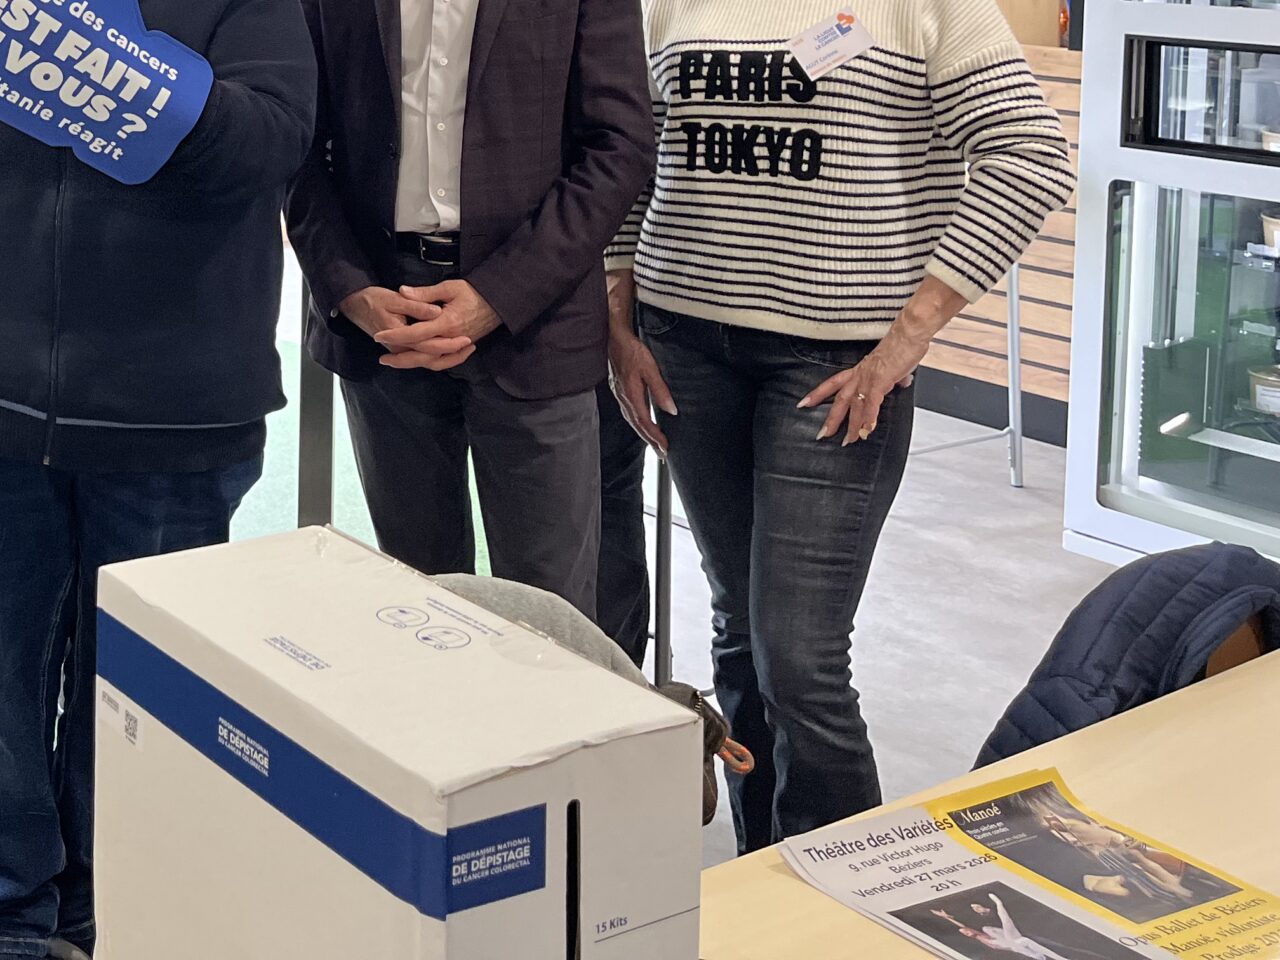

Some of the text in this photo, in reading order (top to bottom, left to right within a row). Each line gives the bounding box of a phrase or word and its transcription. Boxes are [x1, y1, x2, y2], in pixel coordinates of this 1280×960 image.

[69, 0, 105, 32] des
[107, 28, 179, 81] cancers
[4, 43, 117, 123] VOUS
[116, 112, 148, 140] ?
[54, 30, 152, 102] FAIT
[146, 87, 172, 118] !
[679, 50, 818, 103] PARIS
[58, 118, 124, 161] réagit
[680, 122, 823, 182] TOKYO
[218, 724, 269, 769] DE DÉPISTAGE
[955, 803, 1002, 825] Manoé
[452, 836, 531, 863] PROGRAMME NATIONAL
[803, 815, 954, 863] Théâtre des Variétés
[861, 857, 880, 870] rue
[880, 848, 913, 863] Victor
[914, 841, 944, 855] Hugo
[452, 845, 531, 877] DE DÉPISTAGE
[452, 858, 531, 886] DU CANCER COLORECTAL
[851, 853, 999, 899] Vendredi 27 mars 2026
[888, 857, 933, 874] Béziers
[930, 878, 963, 893] 20 h
[595, 915, 628, 935] 15 Kits
[1118, 928, 1162, 946] Opus
[1154, 919, 1204, 936] Ballet
[1198, 911, 1221, 922] de
